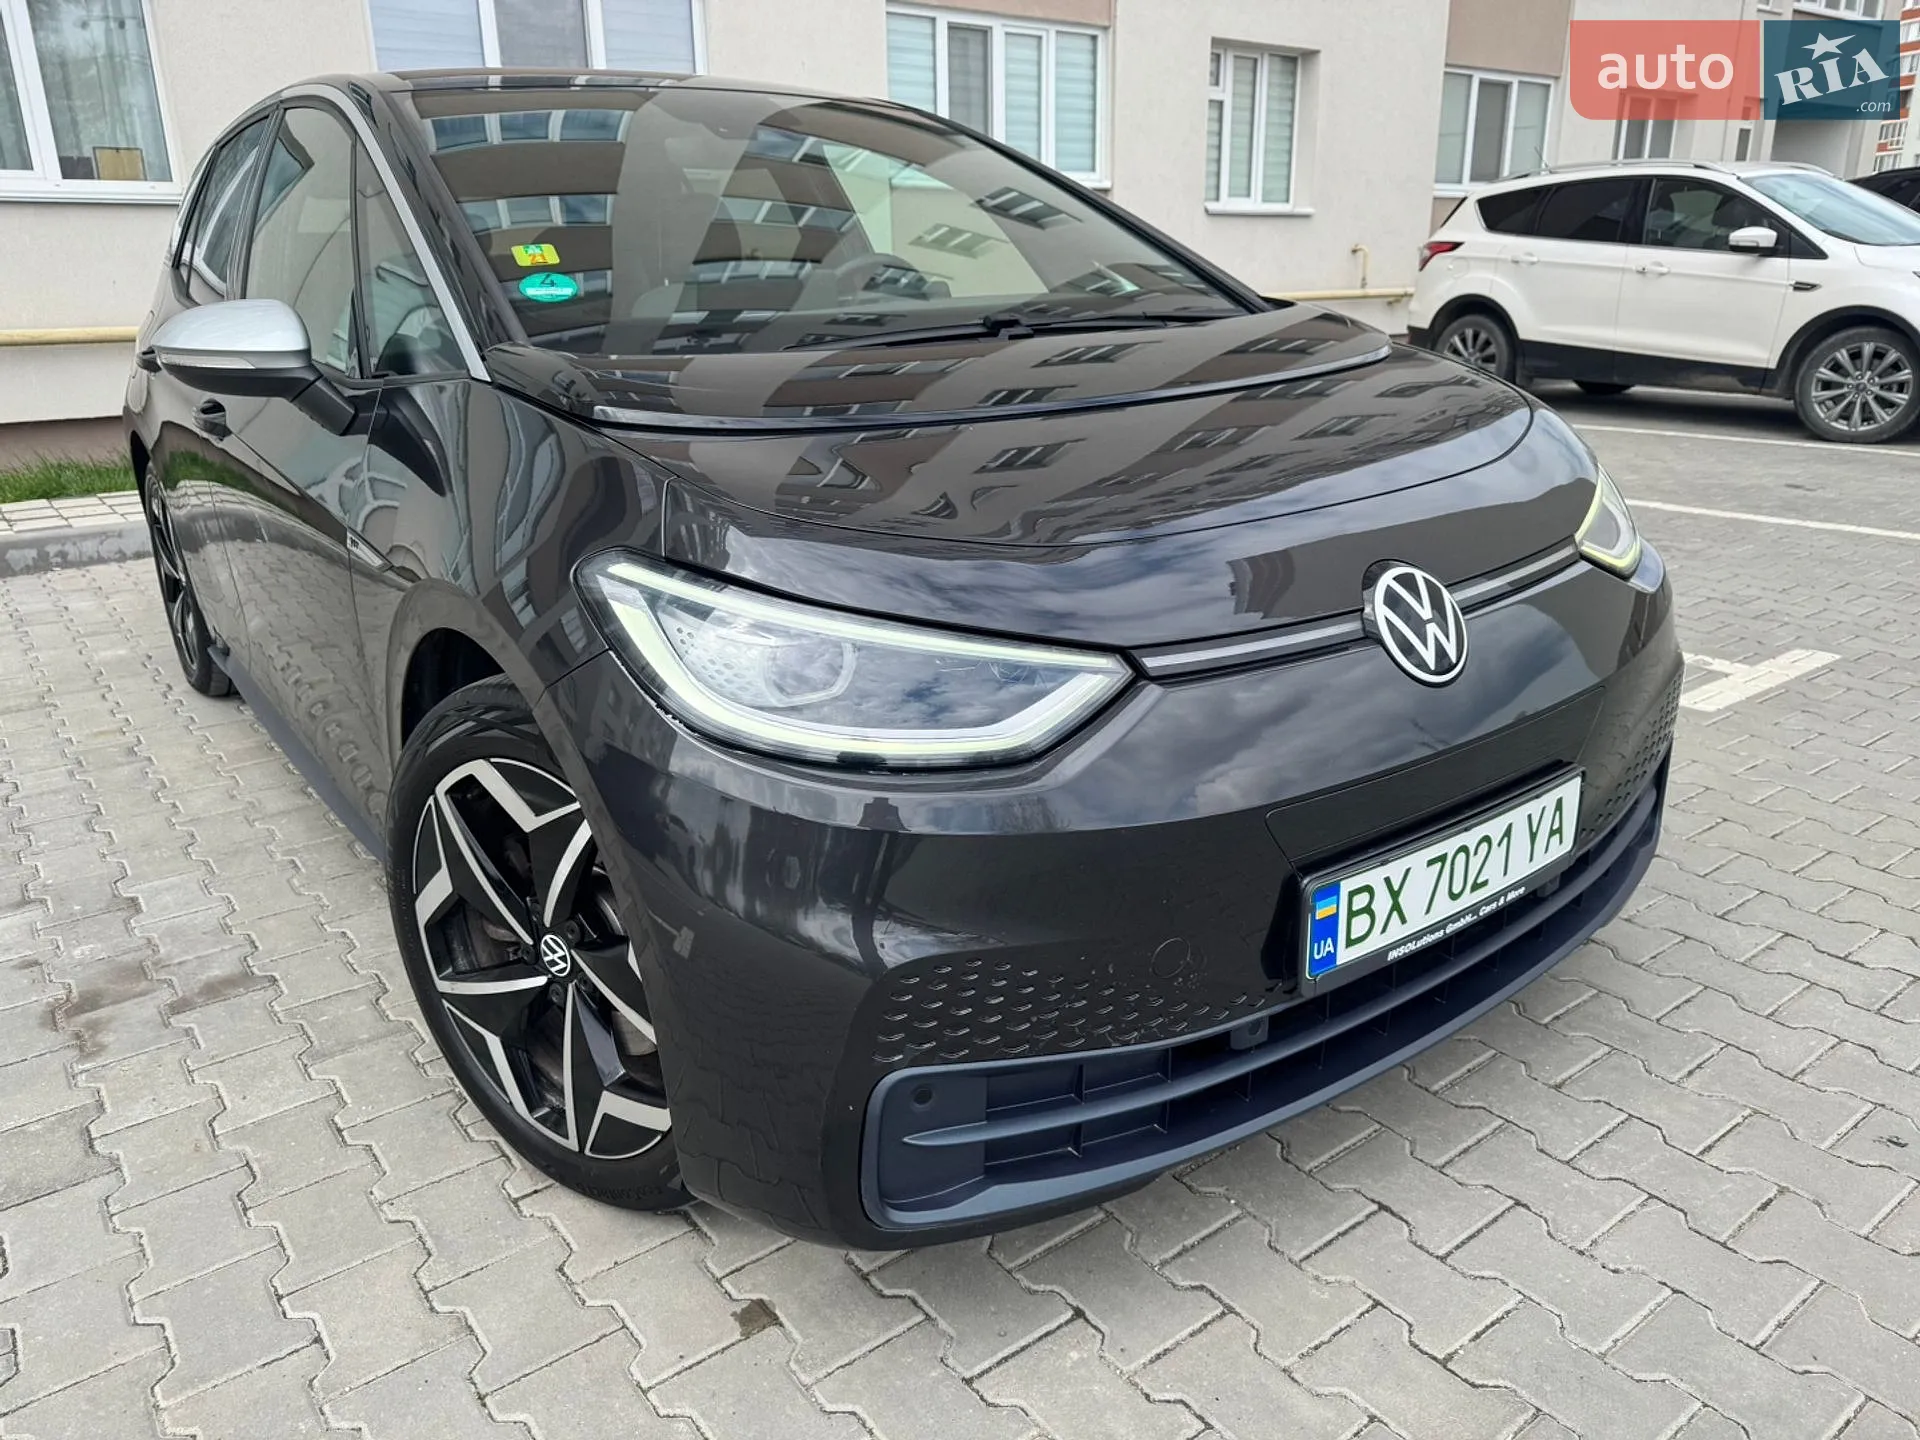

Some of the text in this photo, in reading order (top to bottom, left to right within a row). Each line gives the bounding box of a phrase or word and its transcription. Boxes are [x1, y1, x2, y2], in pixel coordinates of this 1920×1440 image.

[1345, 796, 1564, 949] BX 7021 YA
[1313, 937, 1335, 960] UA
